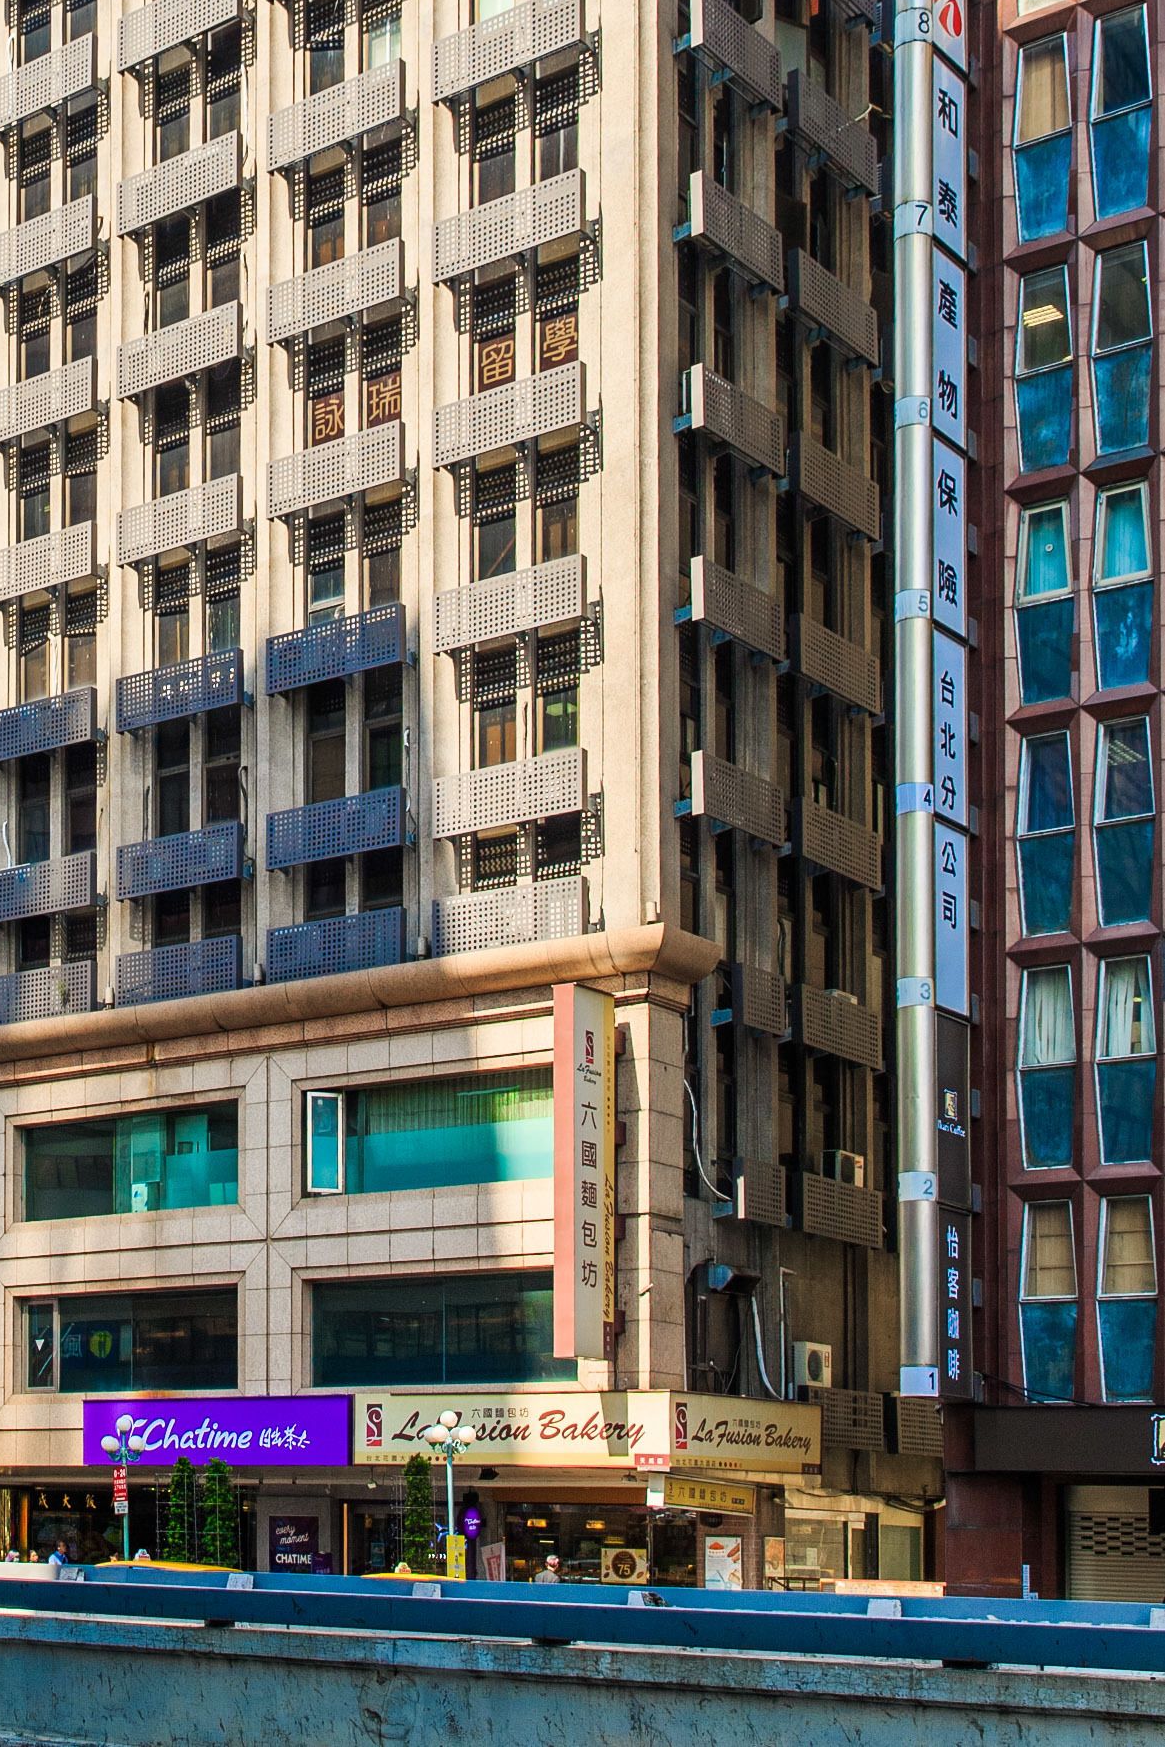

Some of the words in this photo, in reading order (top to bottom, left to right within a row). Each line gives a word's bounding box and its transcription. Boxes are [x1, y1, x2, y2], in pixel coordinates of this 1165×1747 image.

[919, 11, 931, 35] 8
[915, 204, 927, 227] 7
[937, 88, 959, 608] 和泰產物保險
[918, 400, 929, 419] 6
[917, 595, 929, 613] 5
[923, 788, 932, 807] 4
[940, 669, 958, 930] 台北分公司
[919, 983, 932, 1002] 3
[580, 1100, 598, 1289] 六國麵包坊
[922, 1178, 934, 1196] 2
[946, 1224, 961, 1381] 怡客咖啡
[928, 1372, 935, 1391] 1
[470, 1407, 530, 1420] 六國麵包坊
[142, 1416, 253, 1452] Chatime
[538, 1408, 646, 1450] Bakery
[691, 1417, 715, 1443] La
[715, 1420, 762, 1448] Fusion
[764, 1423, 812, 1455] Bakery
[279, 1533, 310, 1546] moment
[275, 1553, 312, 1565] CHATIME
[617, 1564, 632, 1576] 75
